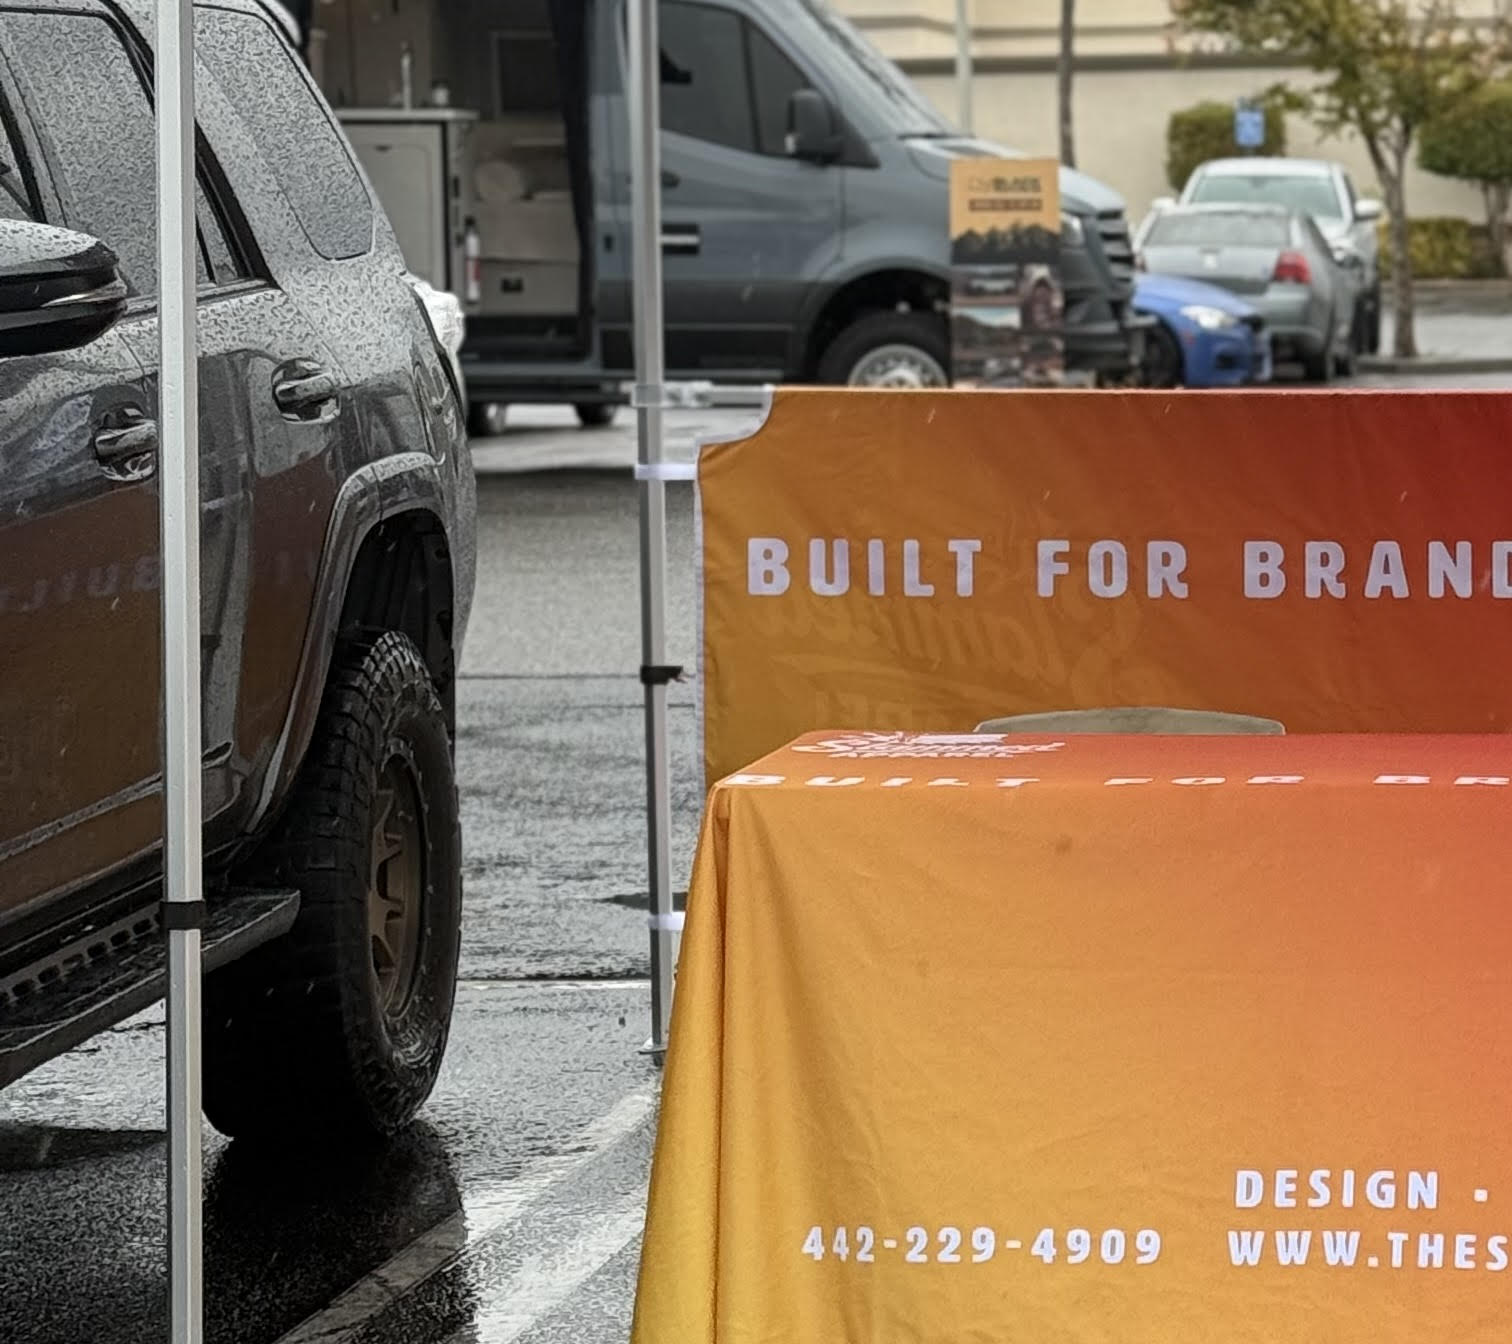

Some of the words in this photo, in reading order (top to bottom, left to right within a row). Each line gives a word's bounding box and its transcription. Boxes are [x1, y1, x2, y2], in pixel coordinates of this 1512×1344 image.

[748, 538, 982, 596] BUILT
[1037, 540, 1188, 598] FOR
[1235, 1169, 1438, 1209] DESIGN
[802, 1226, 1161, 1264] 442-229-4909
